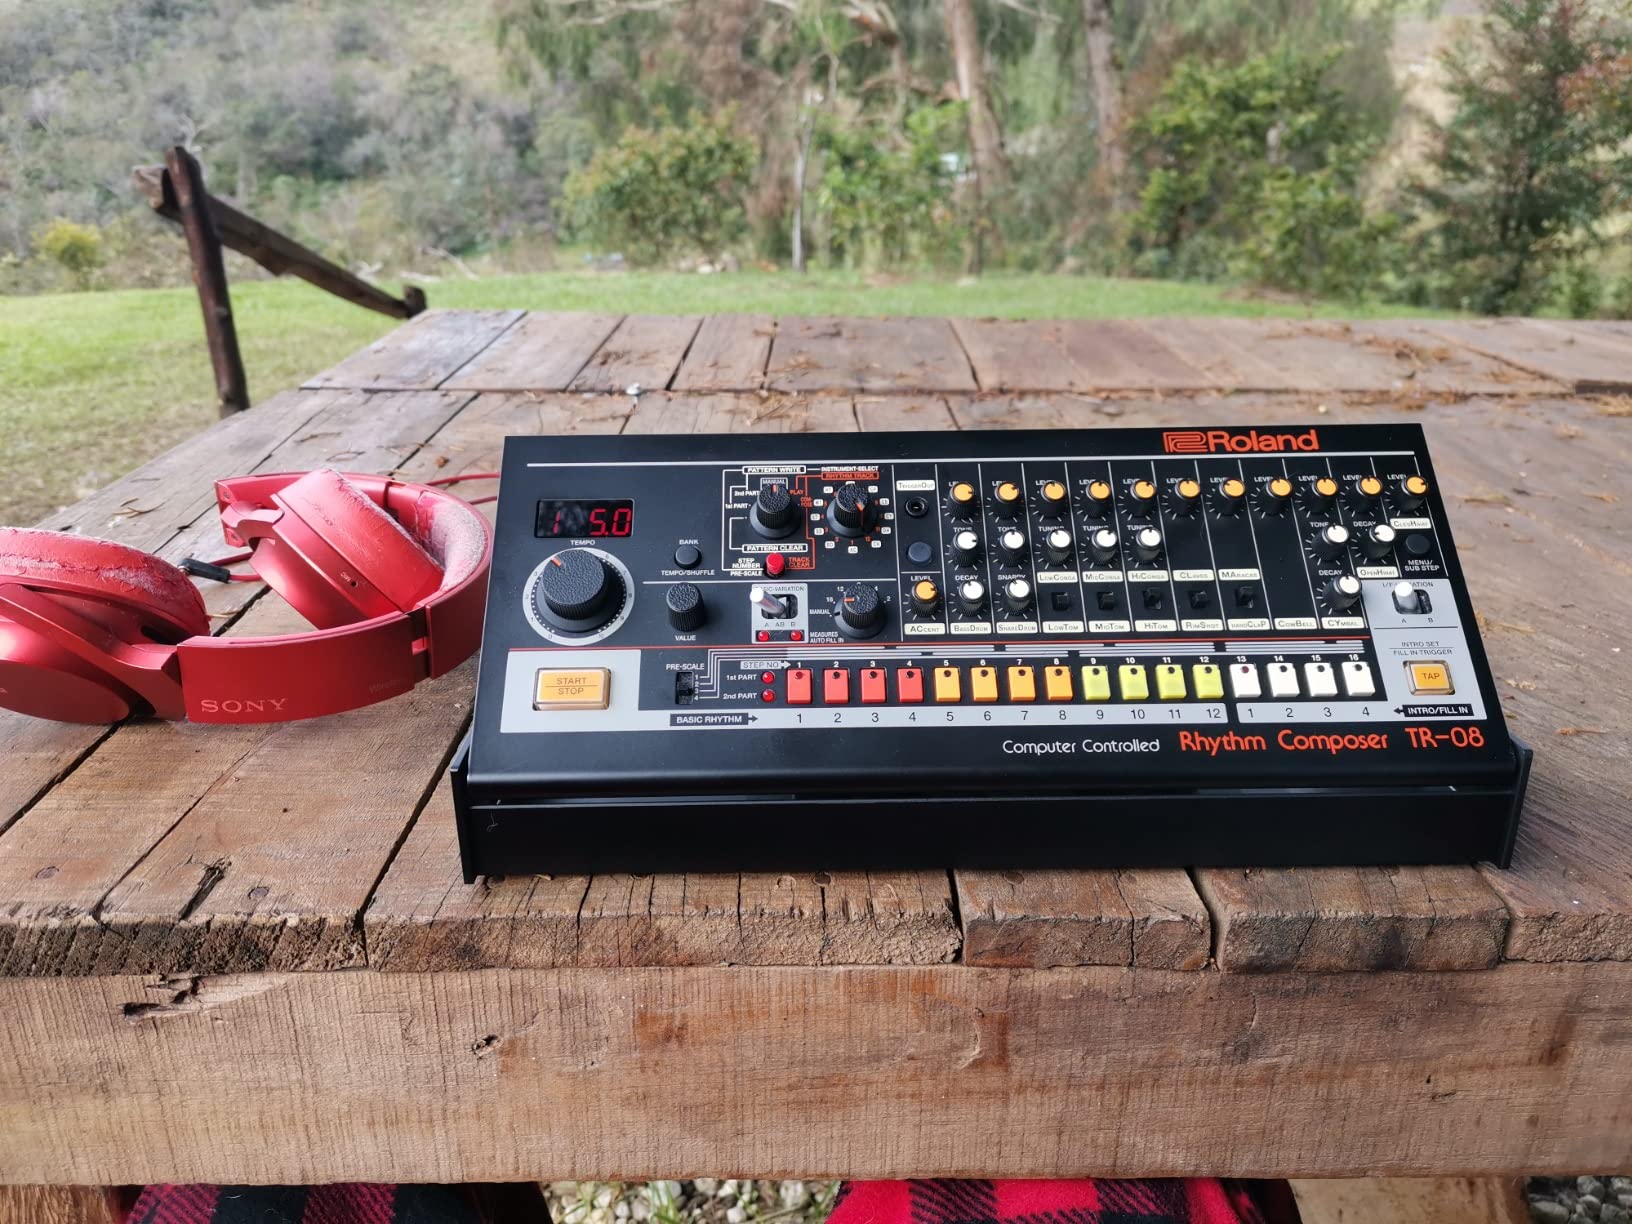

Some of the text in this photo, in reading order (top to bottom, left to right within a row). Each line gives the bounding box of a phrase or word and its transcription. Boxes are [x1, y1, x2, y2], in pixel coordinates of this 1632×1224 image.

[1207, 428, 1320, 453] Roland
[200, 698, 288, 713] SONY
[1248, 708, 1253, 718] 1
[1286, 708, 1294, 718] 2
[1324, 707, 1332, 717] 3
[1362, 706, 1370, 716] 4
[1408, 707, 1458, 715] INTRO/FILL
[797, 713, 802, 723] 1
[834, 712, 842, 723] 2
[872, 712, 879, 722] 3
[909, 712, 916, 722] 4
[946, 711, 954, 721] 5
[984, 710, 991, 721] 6
[1021, 710, 1029, 720] 7
[1059, 710, 1067, 720] 8
[1096, 709, 1104, 720] 9
[1131, 709, 1145, 719] 10
[1169, 709, 1181, 719] 11
[1206, 709, 1221, 719] 12
[1002, 738, 1160, 755] Computer Controlled
[1178, 726, 1485, 756] Rhythm Composer TR-08
